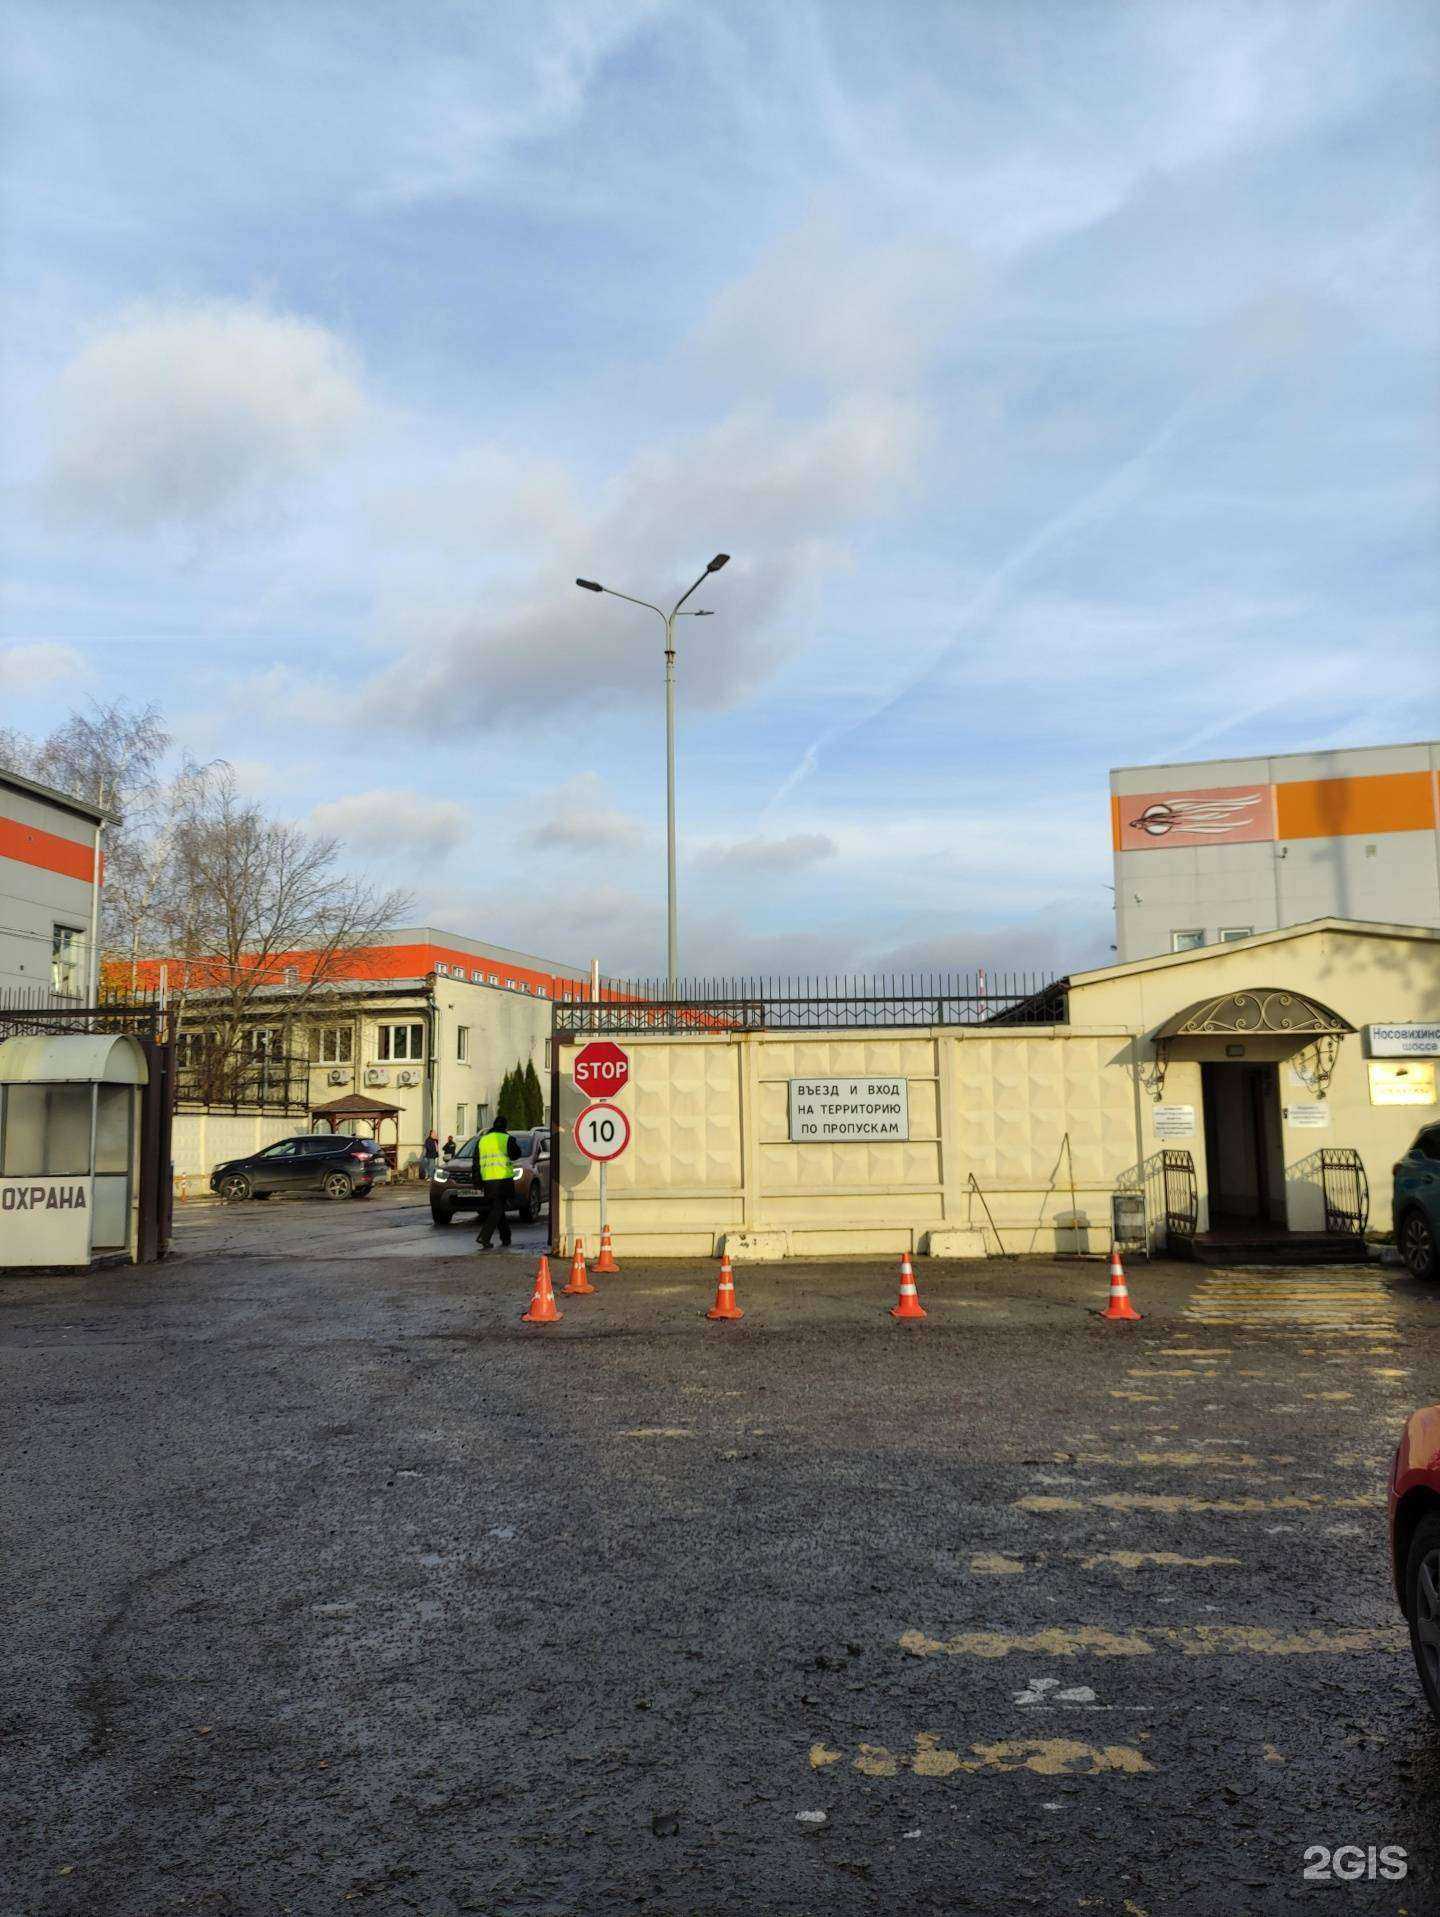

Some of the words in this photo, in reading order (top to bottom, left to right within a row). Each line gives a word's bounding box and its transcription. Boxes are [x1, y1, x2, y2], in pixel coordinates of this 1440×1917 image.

[576, 1061, 627, 1080] STOP
[798, 1085, 839, 1096] ВЪЕЗД
[850, 1085, 858, 1095] И
[868, 1084, 899, 1096] ВХОД
[798, 1105, 814, 1115] НА
[820, 1103, 901, 1115] ТЕРРИТОРИЮ
[589, 1120, 614, 1142] 10
[802, 1124, 817, 1134] ПО
[823, 1123, 899, 1134] ПРОПУСКАМ
[2, 1186, 86, 1210] ОХРАНА
